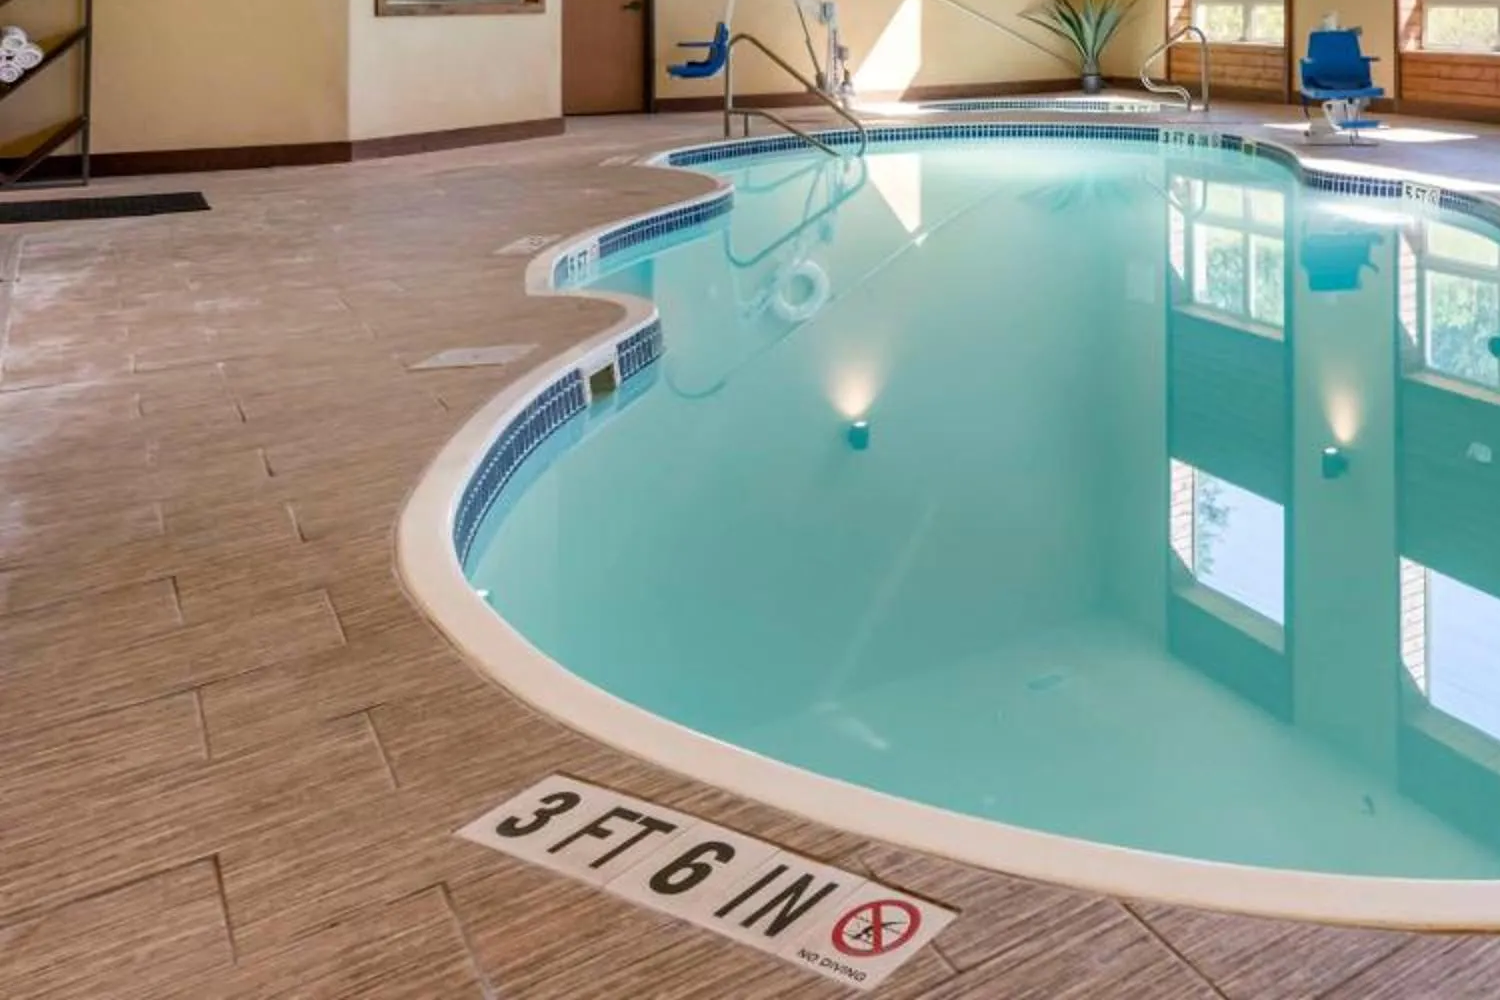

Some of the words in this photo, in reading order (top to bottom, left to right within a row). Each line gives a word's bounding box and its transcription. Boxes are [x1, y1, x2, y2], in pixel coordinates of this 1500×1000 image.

[495, 791, 581, 838] 3
[546, 806, 677, 869] FT
[648, 840, 736, 896] 6
[713, 864, 839, 938] IN
[797, 948, 820, 962] NO
[820, 958, 868, 982] DIVING
